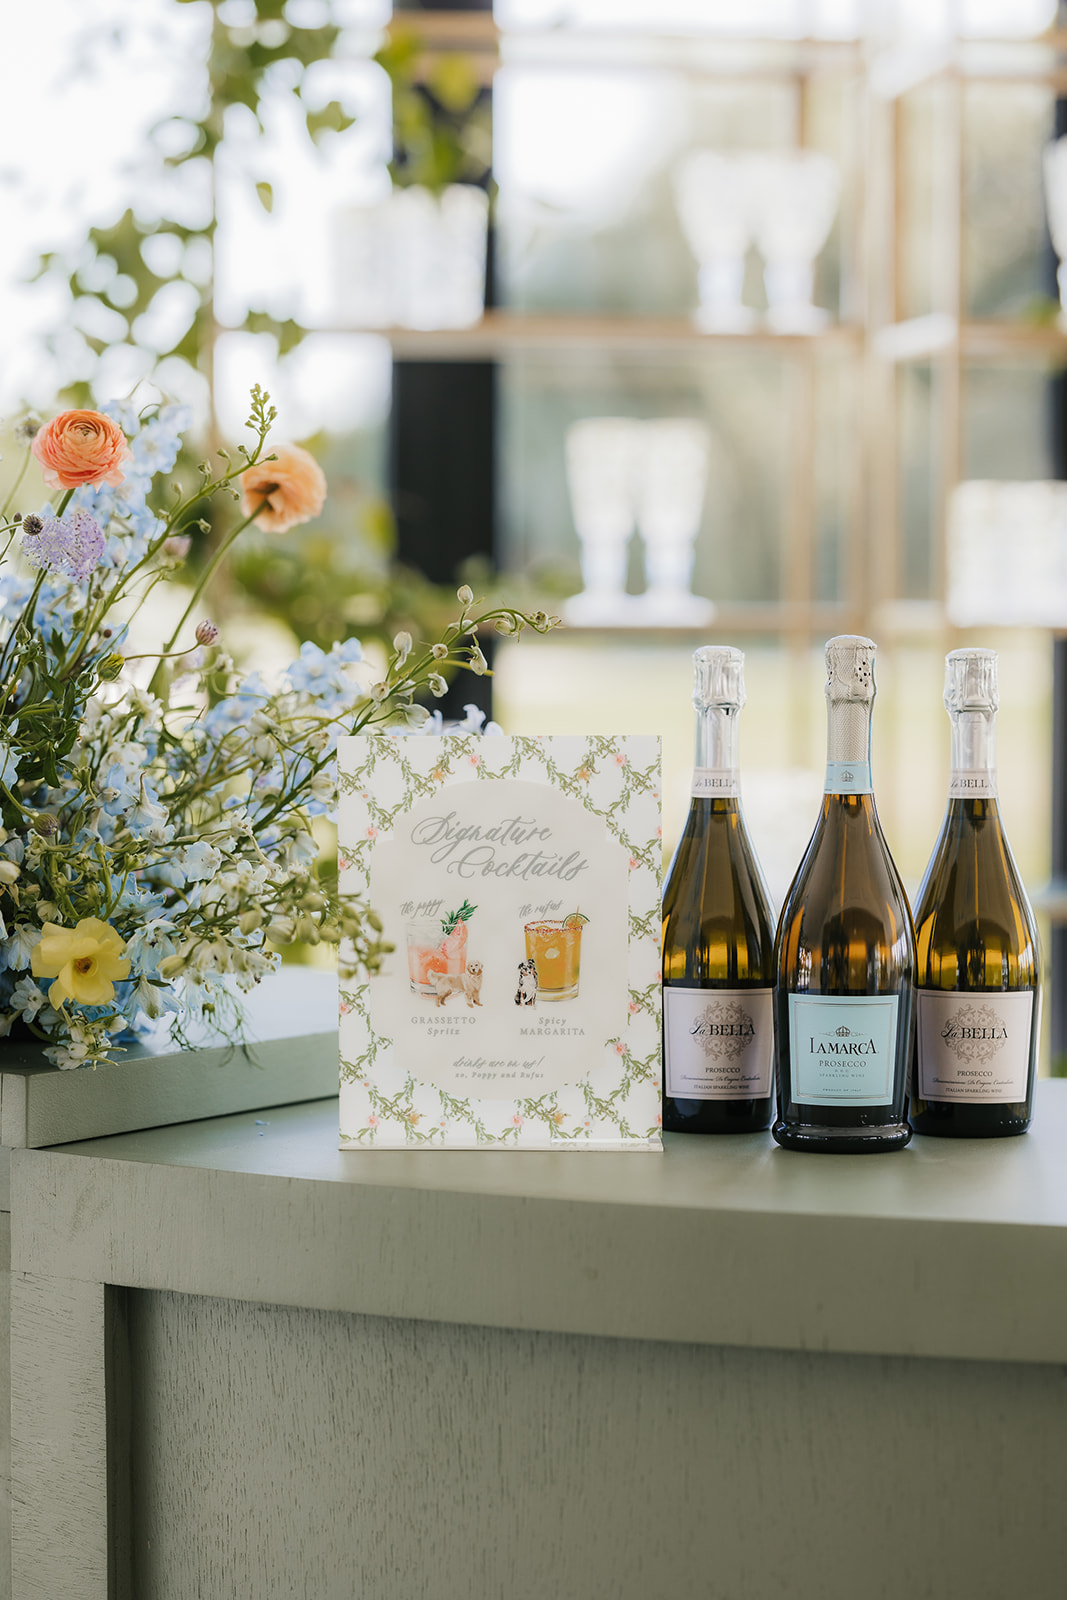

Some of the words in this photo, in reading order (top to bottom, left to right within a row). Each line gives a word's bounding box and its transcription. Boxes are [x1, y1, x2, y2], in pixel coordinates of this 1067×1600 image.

[411, 811, 552, 864] Signature
[447, 846, 589, 881] Cocktails
[400, 900, 415, 916] the
[519, 903, 533, 919] the
[411, 1016, 477, 1025] GRASSETTO
[538, 1017, 567, 1027] Spicy
[427, 1027, 461, 1037] Spritz
[520, 1028, 586, 1036] MARGARITA
[709, 1024, 756, 1036] BELLA
[961, 1027, 1008, 1039] BELLA
[453, 1056, 487, 1069] drinks
[522, 1055, 546, 1069] us!
[819, 1060, 866, 1068] PROSECCO
[472, 1072, 497, 1080] Poppy
[520, 1072, 544, 1080] Rufus
